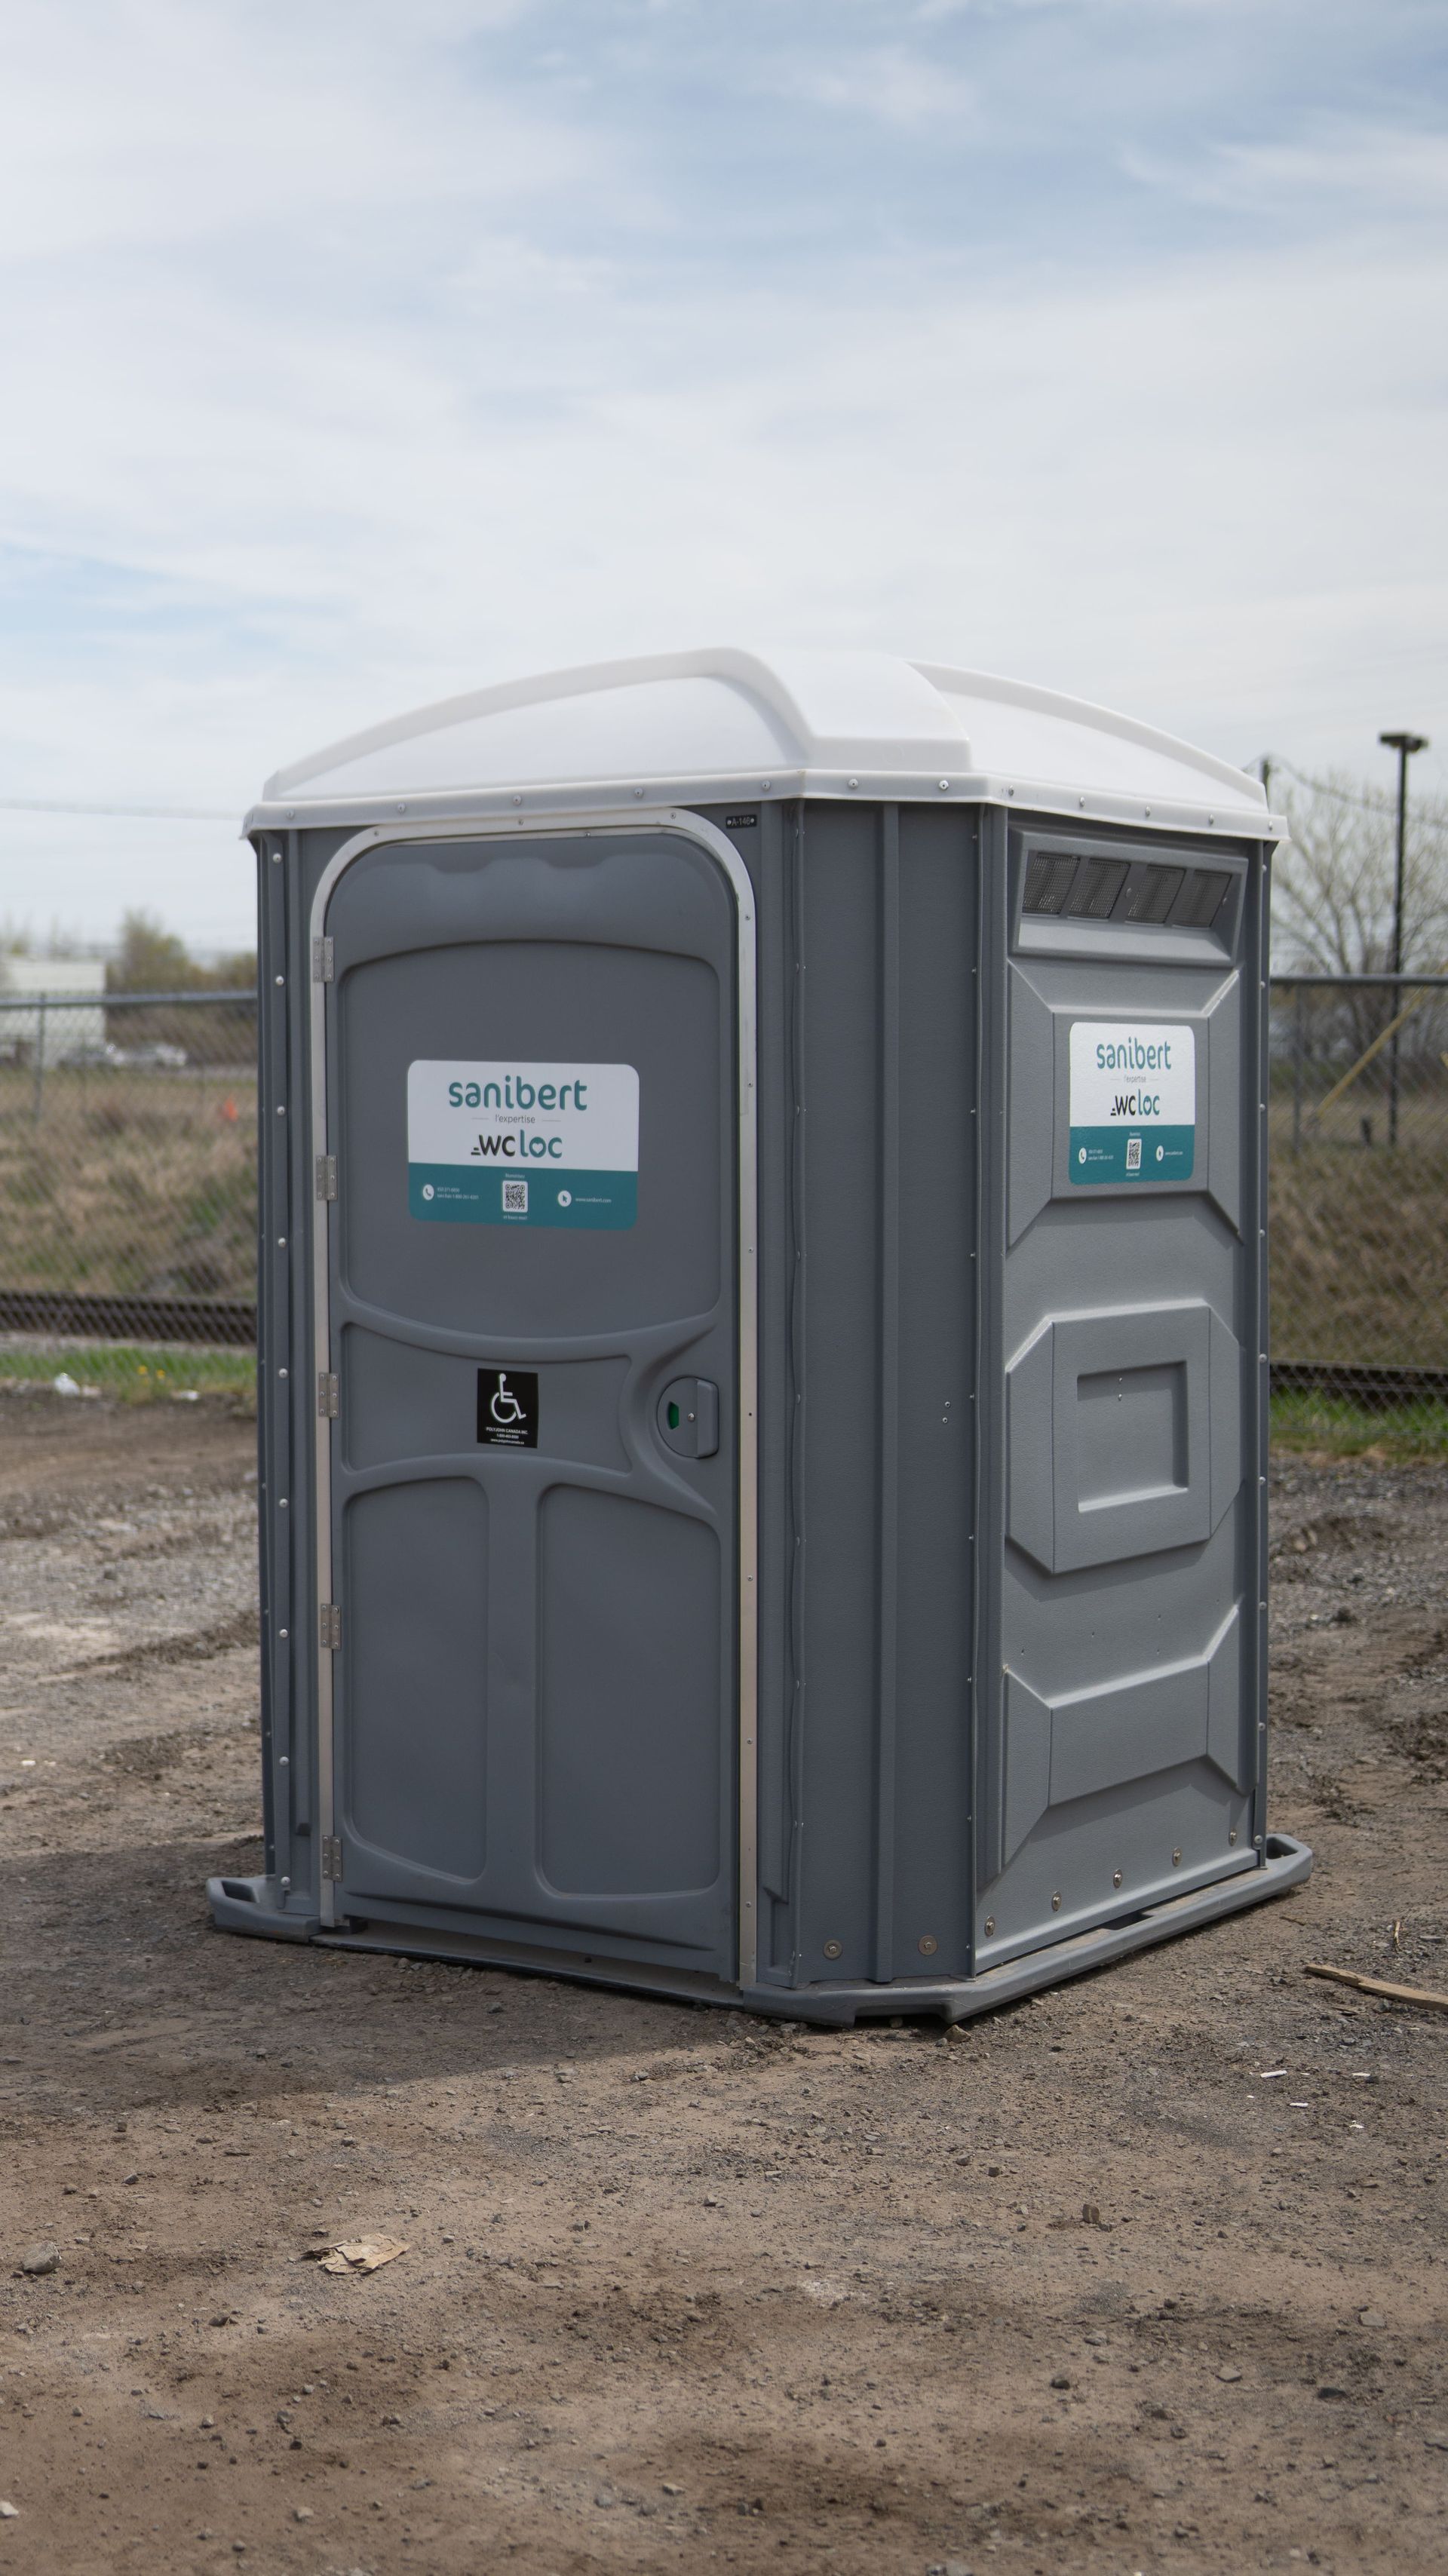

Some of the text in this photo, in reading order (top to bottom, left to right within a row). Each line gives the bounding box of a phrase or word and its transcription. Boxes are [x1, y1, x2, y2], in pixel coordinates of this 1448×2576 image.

[1097, 1036, 1172, 1070] sanibert
[448, 1075, 587, 1112] sanibert
[495, 1114, 536, 1124] l'expertise
